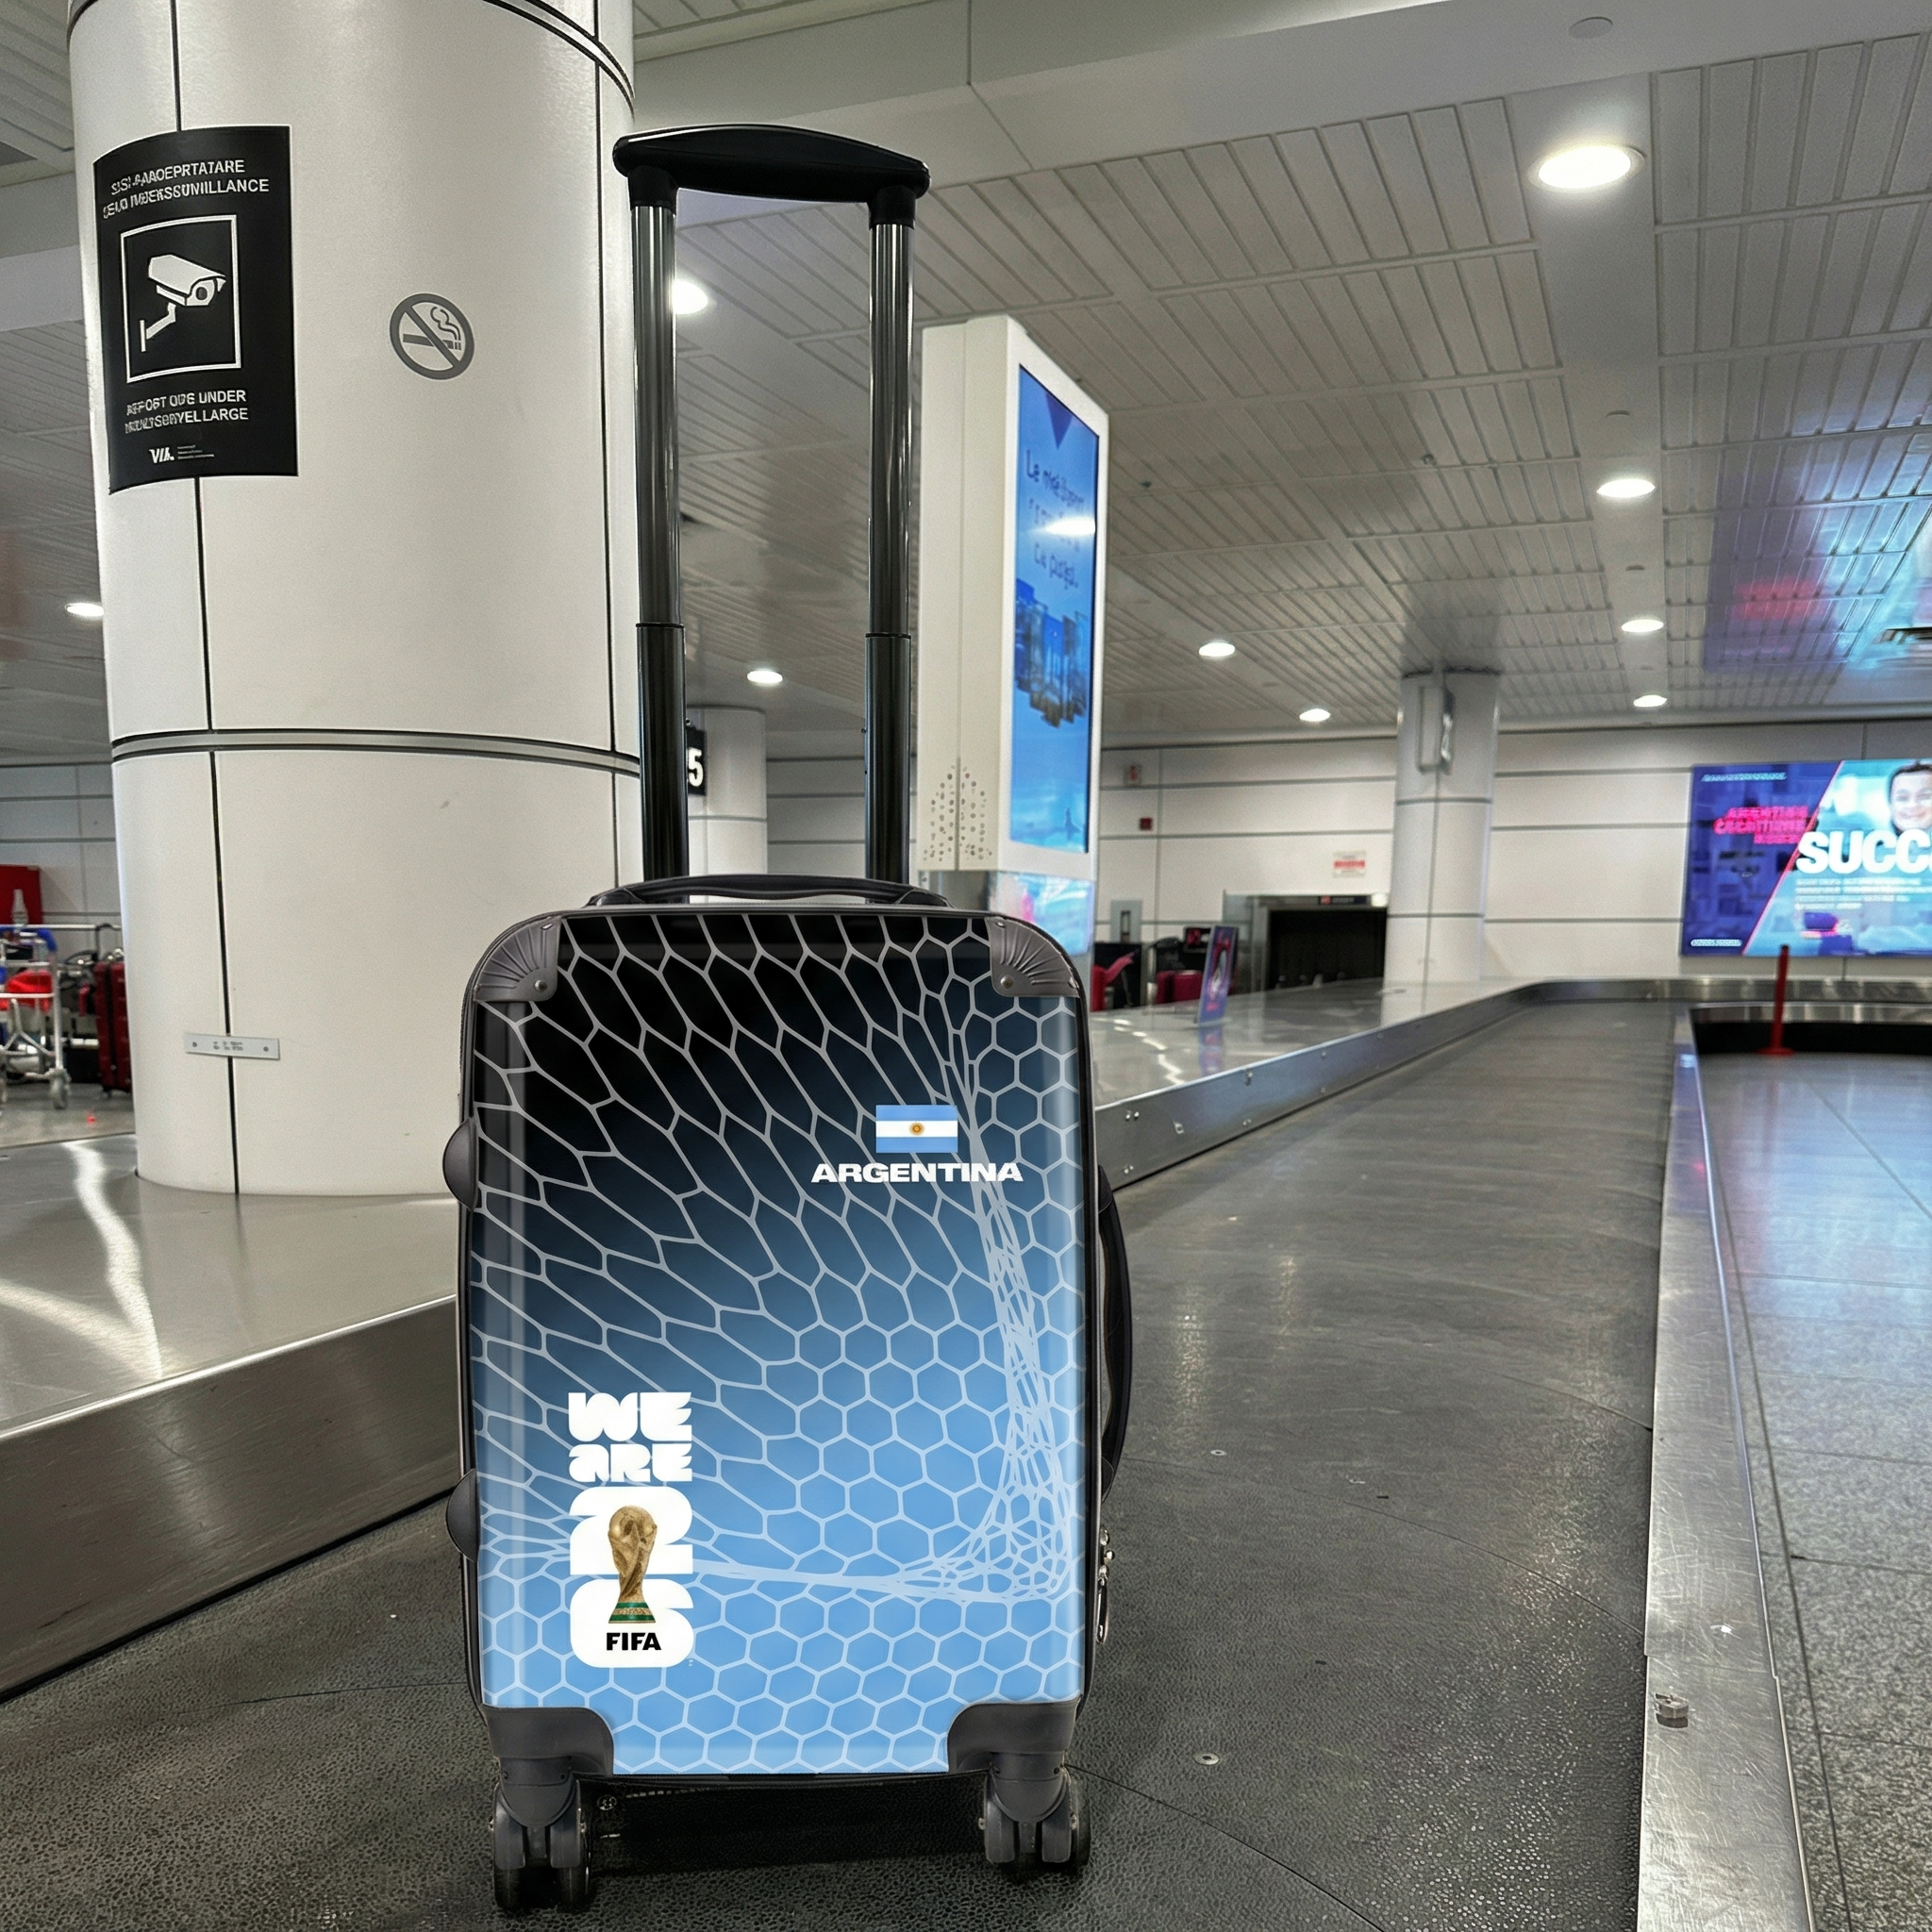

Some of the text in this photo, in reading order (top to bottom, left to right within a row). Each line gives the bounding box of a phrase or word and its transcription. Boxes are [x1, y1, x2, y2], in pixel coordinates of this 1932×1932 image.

[198, 390, 246, 404] UNDER
[688, 746, 704, 787] 5
[1795, 829, 1932, 874] SUCC
[810, 1162, 1024, 1183] ARGENTINA
[568, 1391, 692, 1441] WE
[606, 1632, 662, 1651] FIFA
